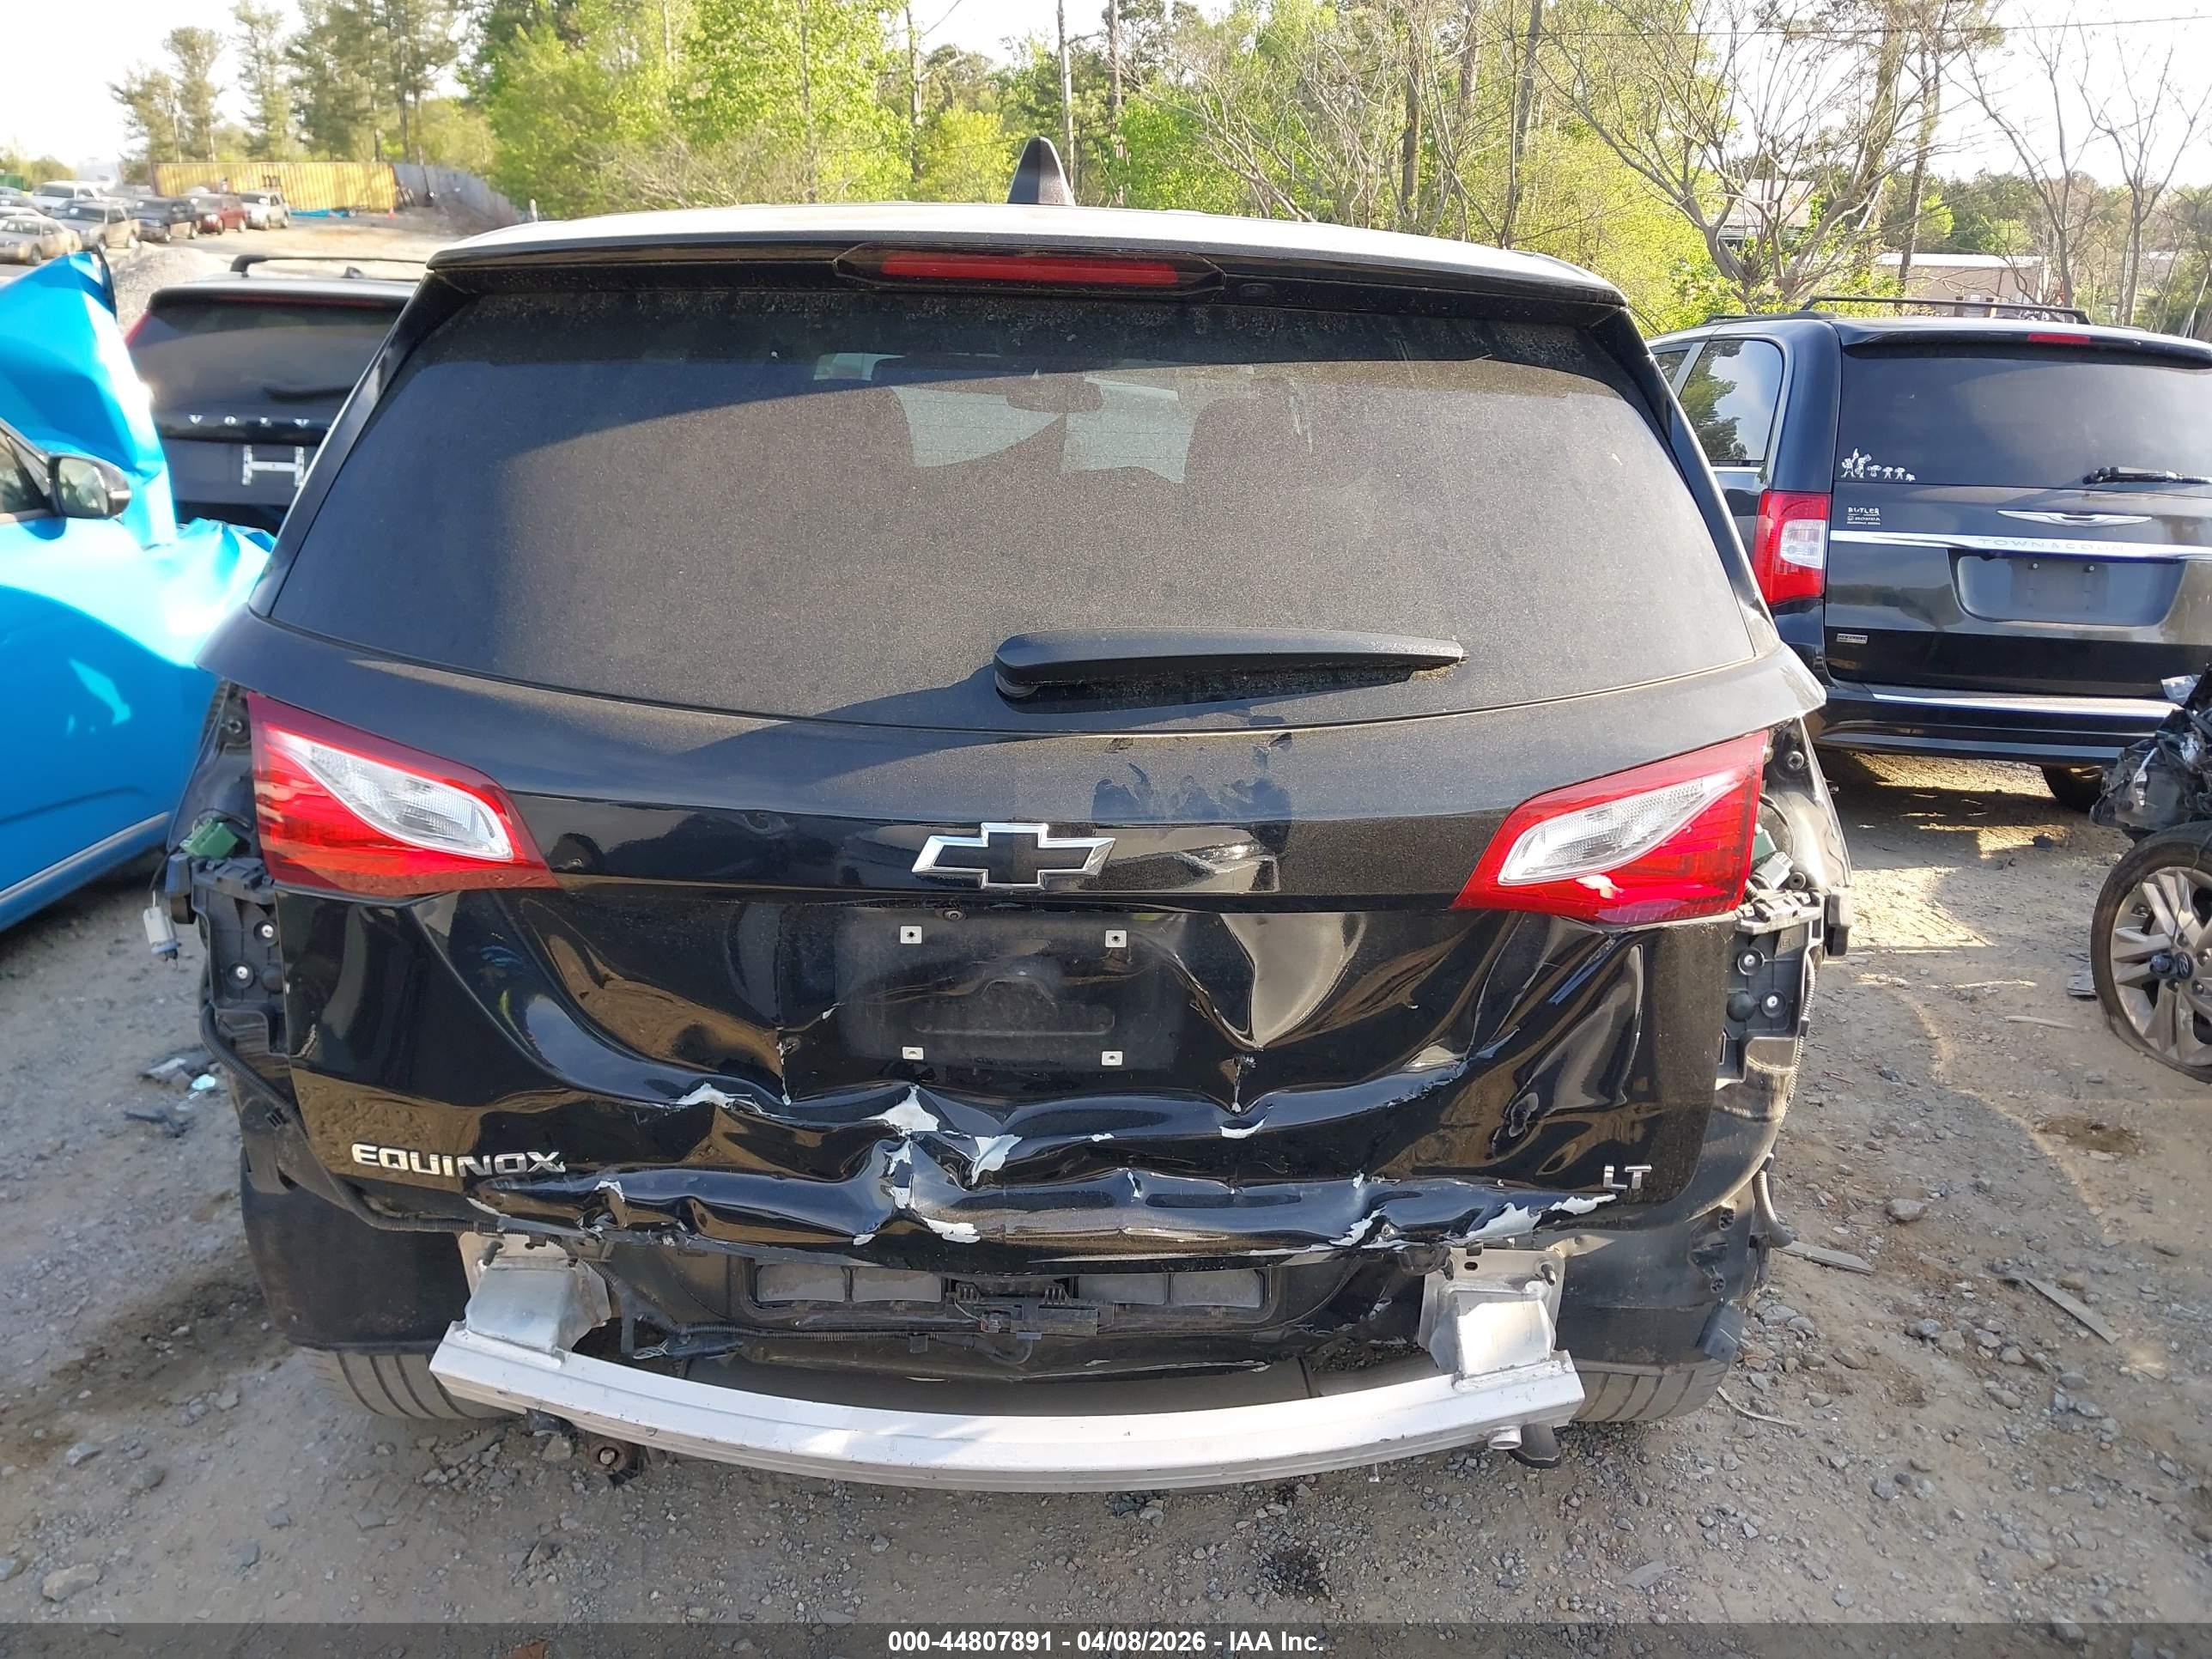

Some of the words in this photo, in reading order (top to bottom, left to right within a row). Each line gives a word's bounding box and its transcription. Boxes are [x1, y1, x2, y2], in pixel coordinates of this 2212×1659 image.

[188, 414, 313, 428] VOLV
[1847, 507, 1880, 515] BUTLER
[1978, 538, 2045, 550] TOWN
[352, 1143, 566, 1177] EQUINOX
[1602, 1164, 1652, 1189] LT
